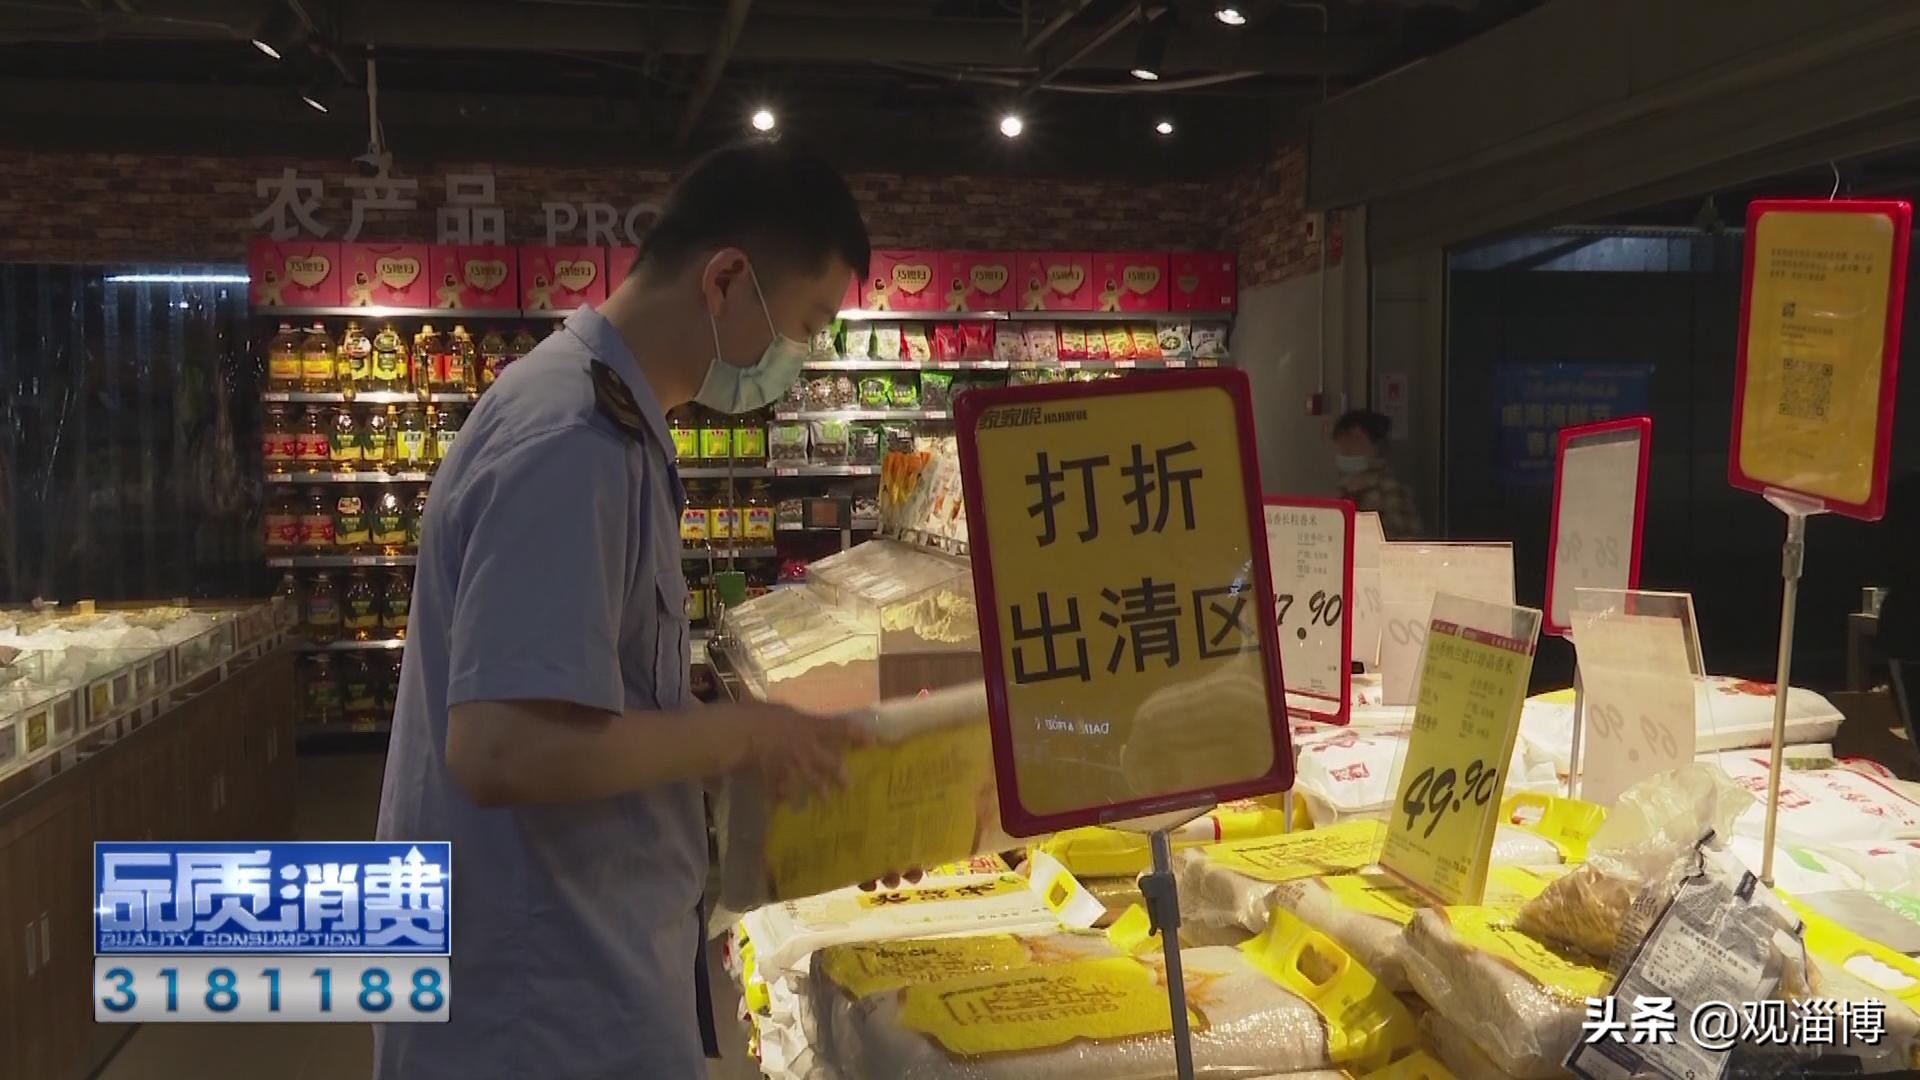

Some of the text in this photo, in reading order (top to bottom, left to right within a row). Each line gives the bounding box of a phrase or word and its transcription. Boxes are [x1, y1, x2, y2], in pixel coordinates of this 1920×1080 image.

[250, 168, 506, 246] 农产品
[978, 407, 1042, 431] 家家悦
[1025, 441, 1204, 548] 打折
[1010, 577, 1262, 685] 出清区
[1274, 589, 1343, 641] 7.90
[1402, 759, 1500, 840] 49.90
